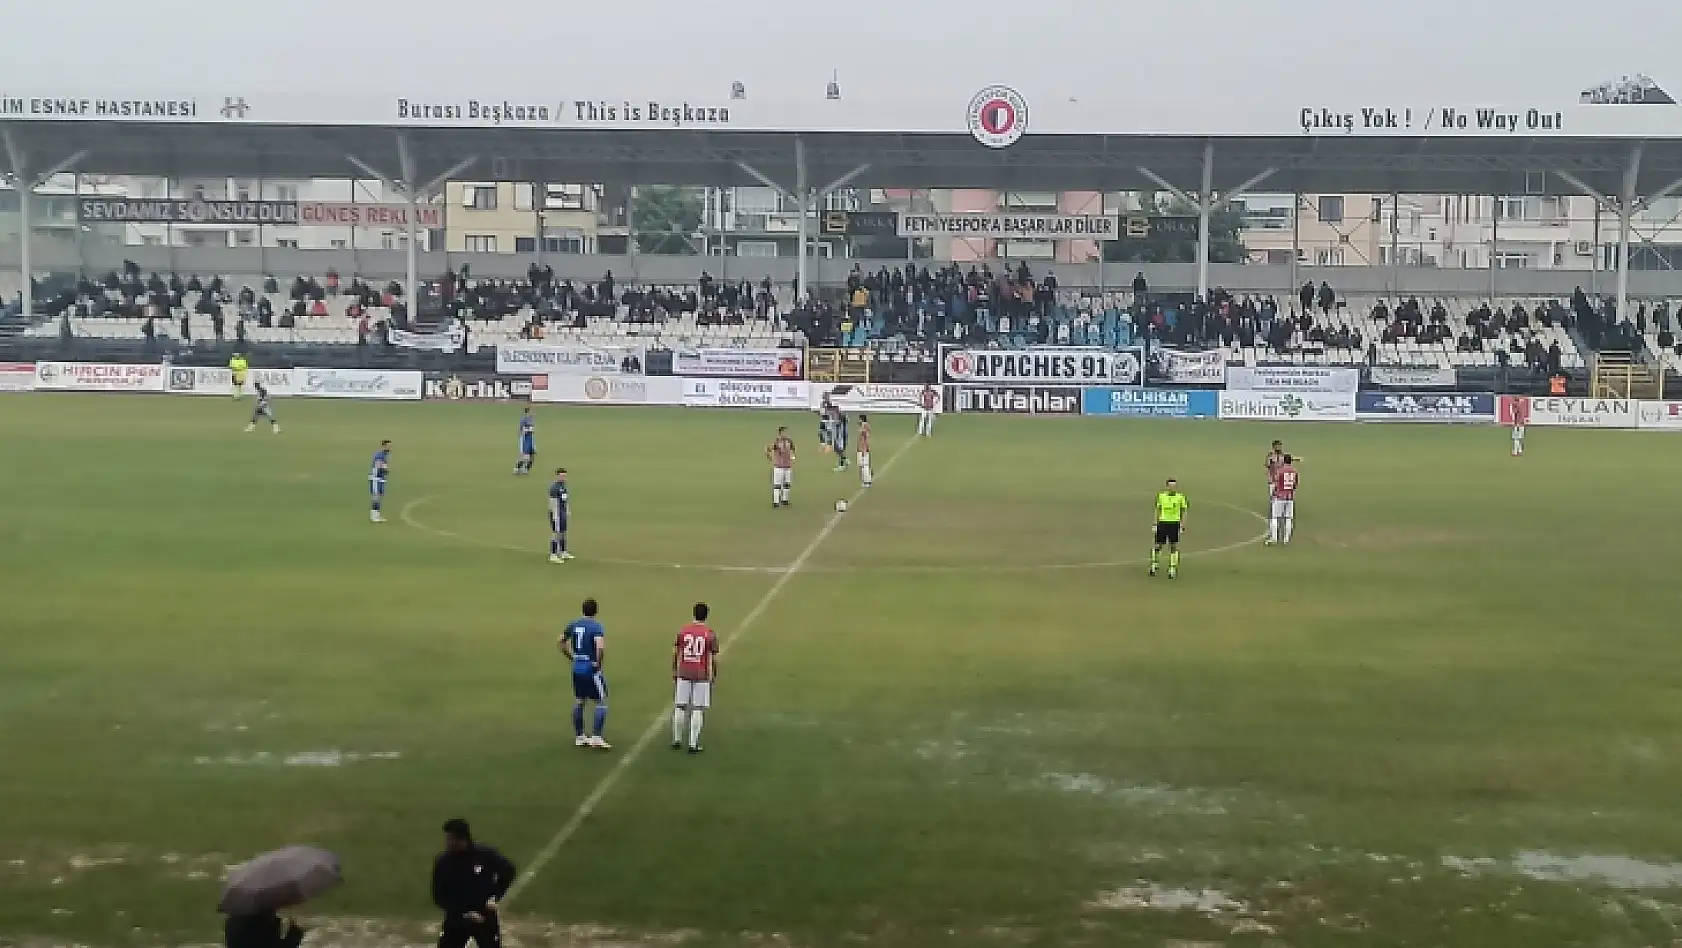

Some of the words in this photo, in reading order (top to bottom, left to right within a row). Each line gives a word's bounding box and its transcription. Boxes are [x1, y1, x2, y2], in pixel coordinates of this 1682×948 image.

[30, 97, 90, 115] ESNAF
[95, 97, 197, 117] HASTANESİ
[397, 98, 461, 119] Burası
[468, 99, 549, 125] Beşkaza
[574, 101, 617, 121] This
[623, 101, 642, 121] is
[648, 102, 730, 127] Beşkaza
[1299, 107, 1354, 134] Çıkış
[1361, 107, 1399, 129] Yok
[1441, 108, 1468, 130] No
[1474, 108, 1520, 132] Way
[1525, 108, 1563, 130] Out
[975, 354, 1076, 377] APACHES
[1081, 354, 1107, 377] 91
[970, 388, 1078, 410] Tufanlar
[1221, 398, 1278, 417] Birikim
[1532, 398, 1629, 414] CEYLAN
[683, 633, 706, 656] 20
